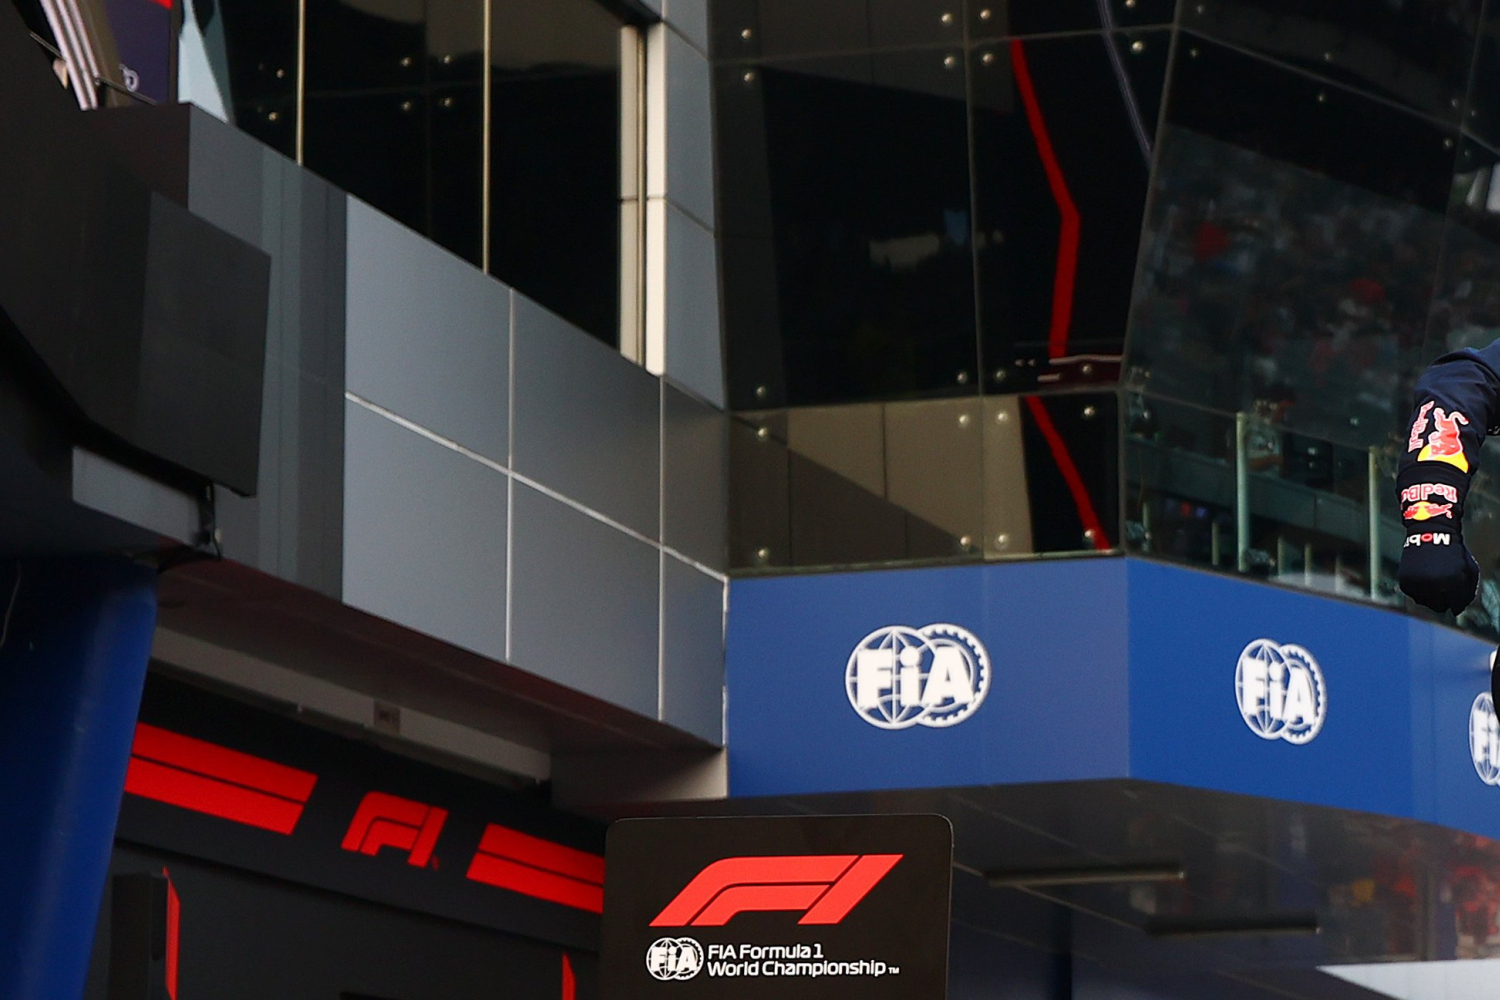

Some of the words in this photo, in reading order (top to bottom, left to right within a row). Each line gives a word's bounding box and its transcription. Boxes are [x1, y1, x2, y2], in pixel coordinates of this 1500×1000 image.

[707, 944, 737, 960] FIA
[738, 943, 813, 961] Formula
[812, 943, 825, 959] 1
[707, 960, 760, 978] World
[761, 959, 887, 980] Championship
